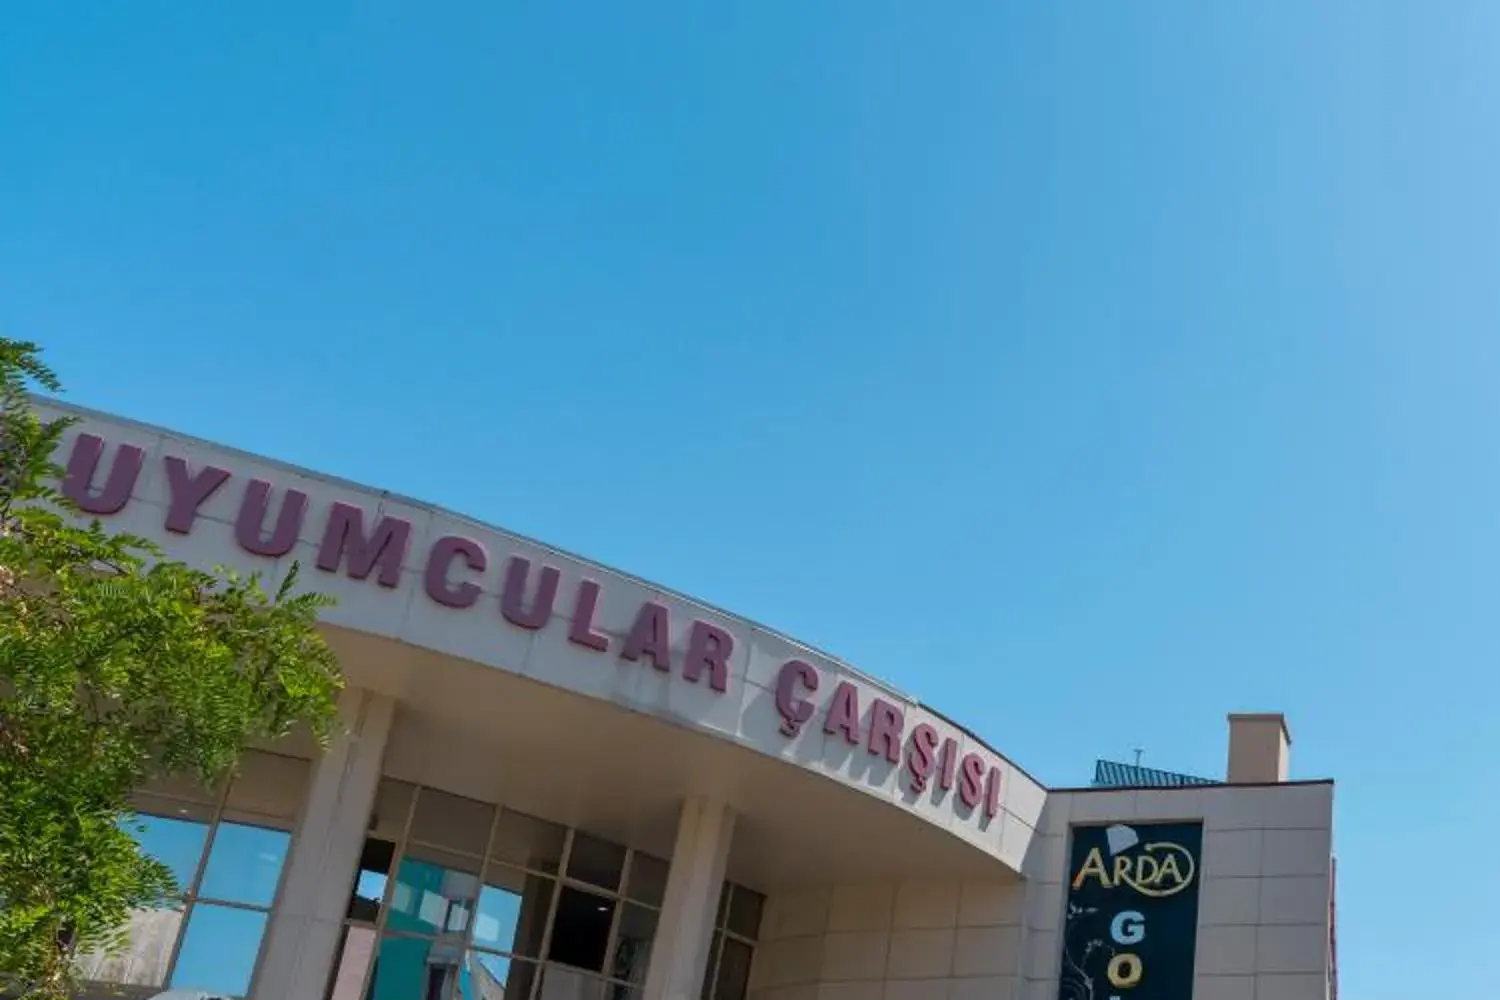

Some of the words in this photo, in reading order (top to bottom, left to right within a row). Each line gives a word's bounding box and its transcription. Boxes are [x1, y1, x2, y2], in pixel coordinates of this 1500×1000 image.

[62, 433, 735, 693] UYUMCULAR
[775, 660, 1001, 820] ÇARŞISI
[1072, 846, 1189, 893] ARDA
